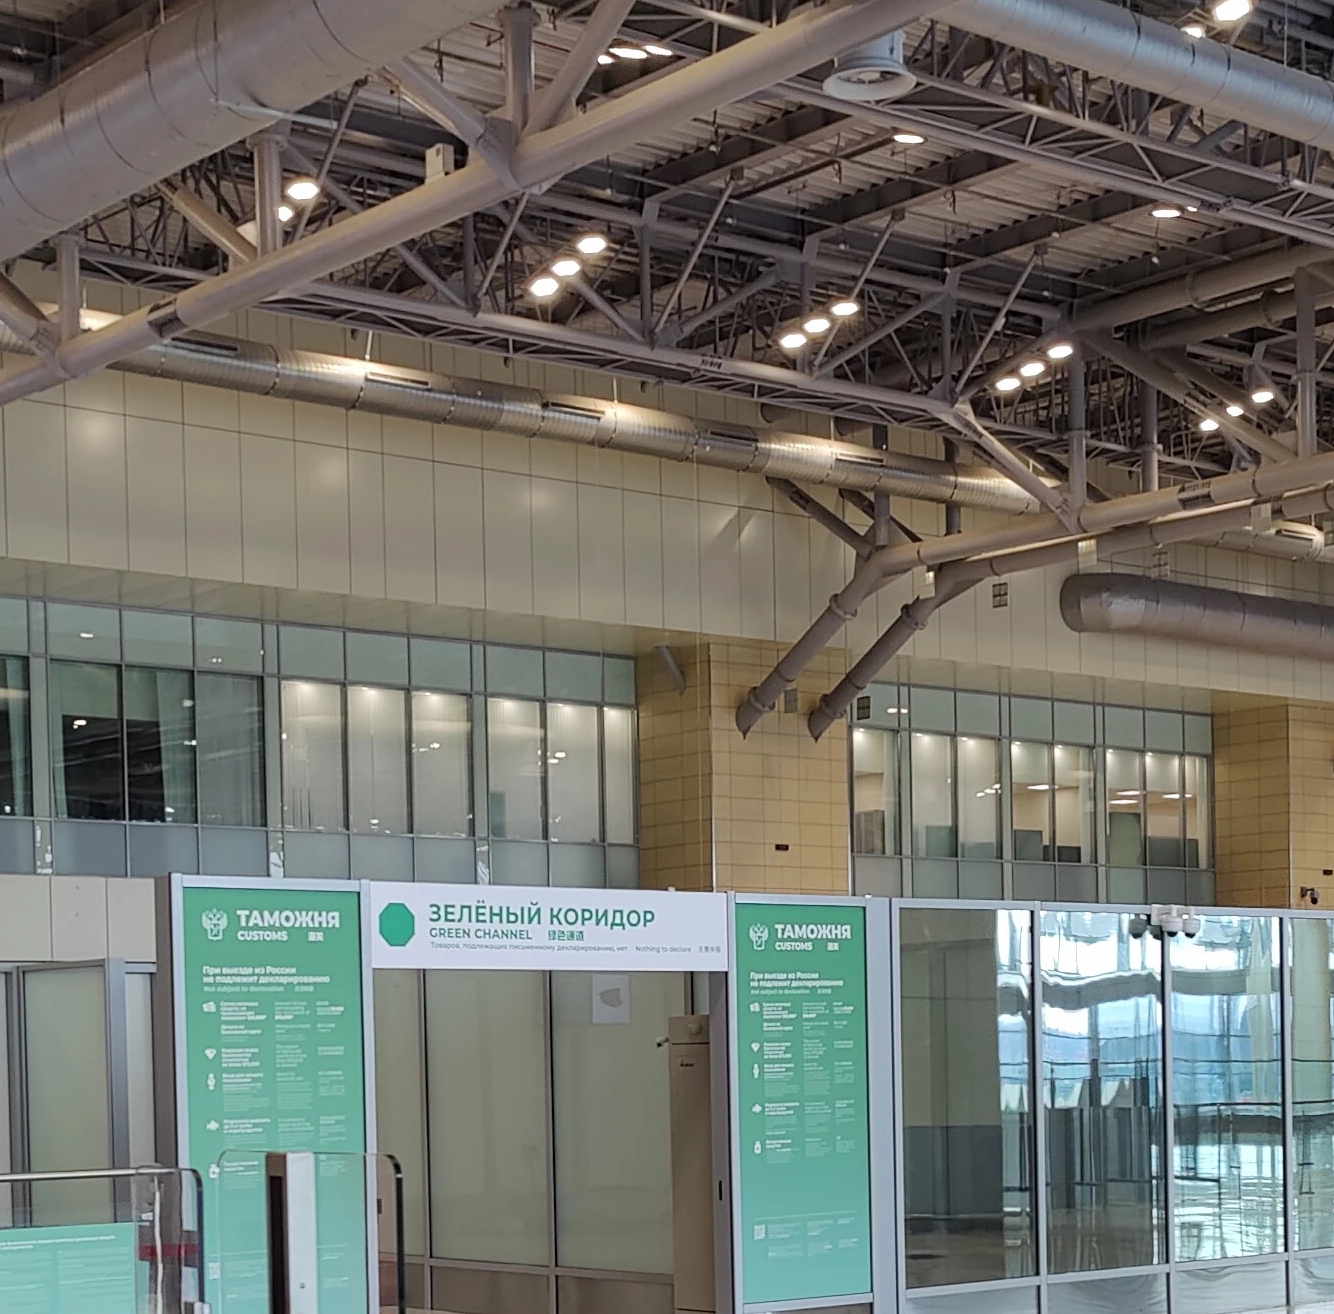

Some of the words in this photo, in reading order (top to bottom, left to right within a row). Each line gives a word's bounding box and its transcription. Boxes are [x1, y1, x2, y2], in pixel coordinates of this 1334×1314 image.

[236, 910, 340, 928] ТАМОЖНЯ
[429, 900, 542, 926] ЗЕЛЁНЫЙ
[550, 907, 655, 931] КОРИДОР
[237, 930, 288, 941] CUSTOMS
[429, 927, 471, 939] GREEN
[475, 928, 532, 941] CHANNEL
[775, 924, 851, 939] ТАМОЖНЯ
[775, 942, 813, 951] CUSTOMS
